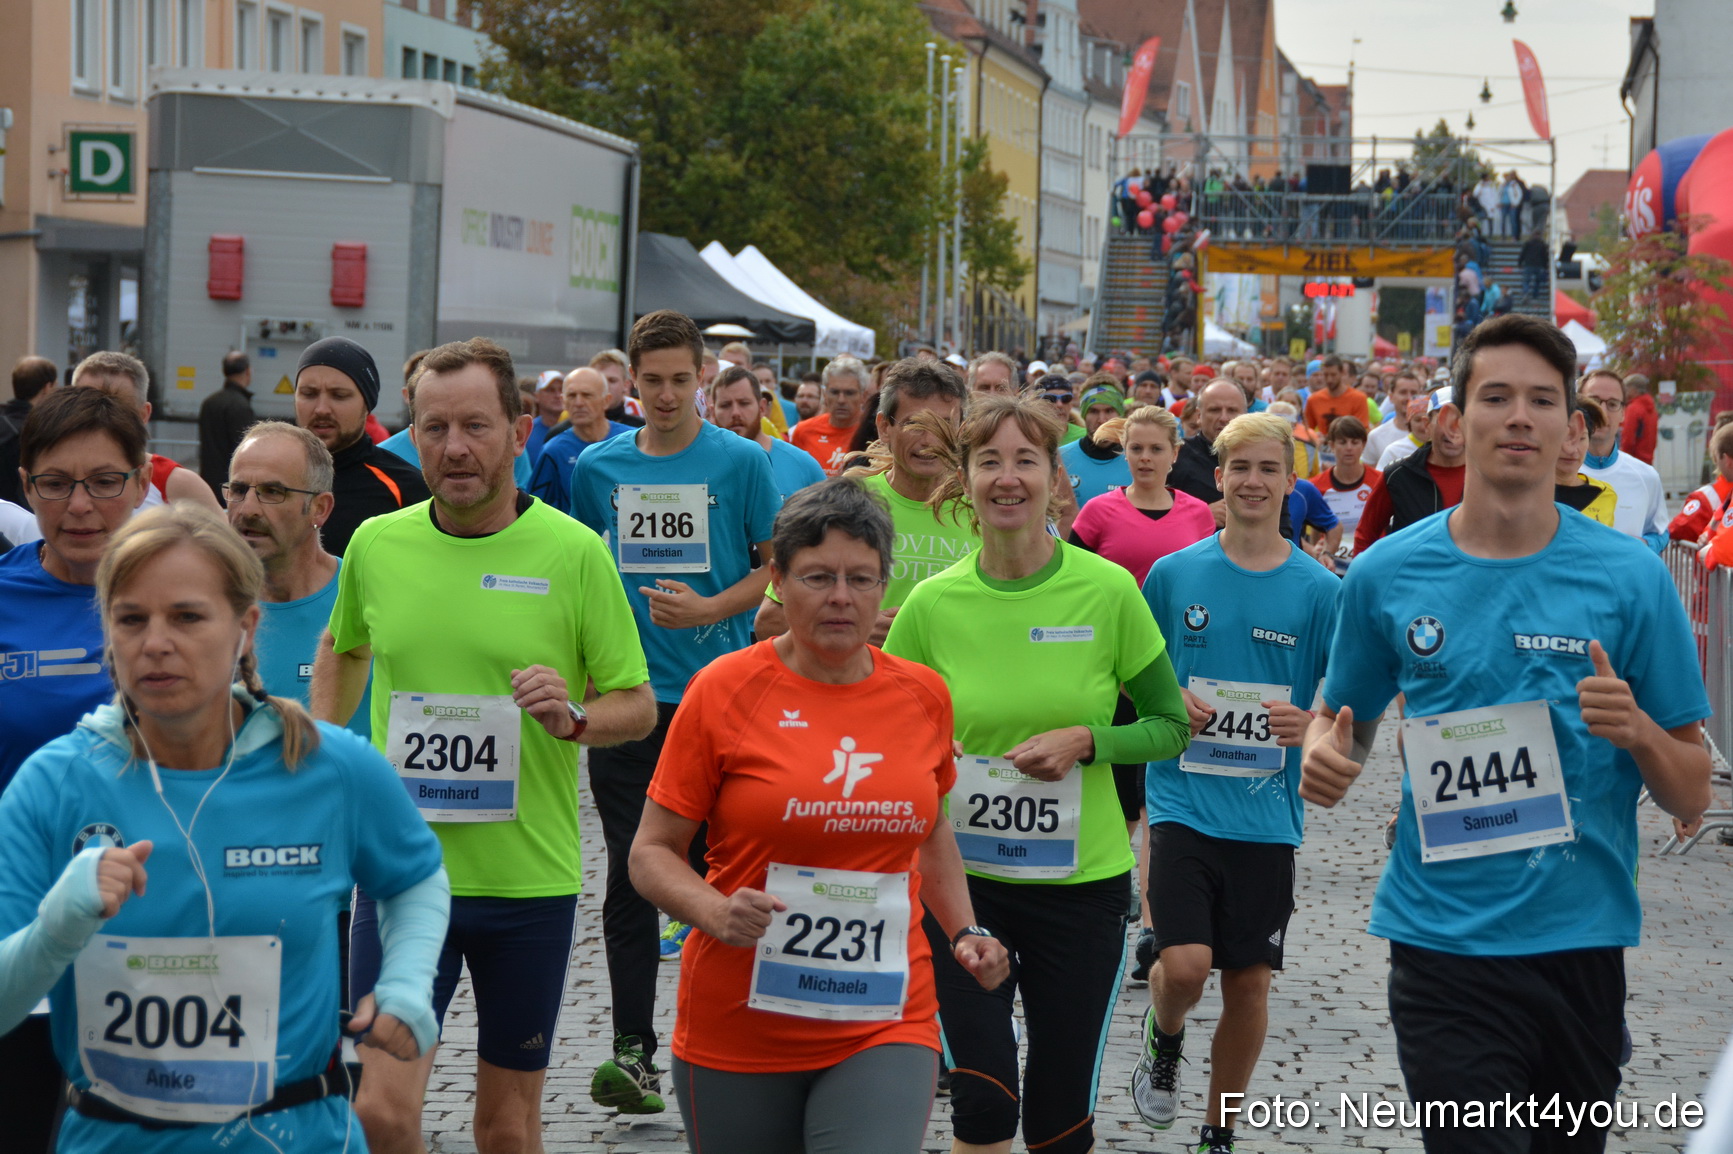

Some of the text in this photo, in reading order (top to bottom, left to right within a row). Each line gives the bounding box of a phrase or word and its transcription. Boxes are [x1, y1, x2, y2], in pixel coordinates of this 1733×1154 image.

[79, 140, 125, 186] D
[570, 206, 619, 290] BOCK
[1303, 251, 1357, 272] ZIEL
[630, 512, 694, 539] 2186
[642, 547, 683, 558] Christian
[891, 532, 971, 558] OVINA
[889, 560, 950, 580] OTE
[1252, 627, 1298, 646] BOCK
[1514, 633, 1587, 655] BOCK
[1226, 689, 1261, 700] BOCK
[435, 705, 480, 718] BOCK
[779, 719, 809, 728] erima
[1200, 711, 1272, 741] 2443
[1453, 718, 1506, 738] BOCK
[404, 732, 498, 772] 2304
[1209, 747, 1257, 761] Jonathan
[1430, 746, 1537, 803] 2444
[418, 784, 480, 800] Bernhard
[782, 797, 913, 822] funrunners
[968, 793, 1059, 833] 2305
[1463, 808, 1518, 831] Samuel
[79, 825, 121, 842] BMW
[823, 815, 927, 834] neumarkt
[224, 844, 321, 868] BOCK
[997, 843, 1027, 858] Ruth
[828, 884, 878, 899] BOCK
[782, 912, 885, 962] 2231
[147, 955, 219, 970] BOCK
[798, 974, 868, 995] Michaela
[103, 990, 245, 1050] 2004
[146, 1068, 196, 1090] Anke
